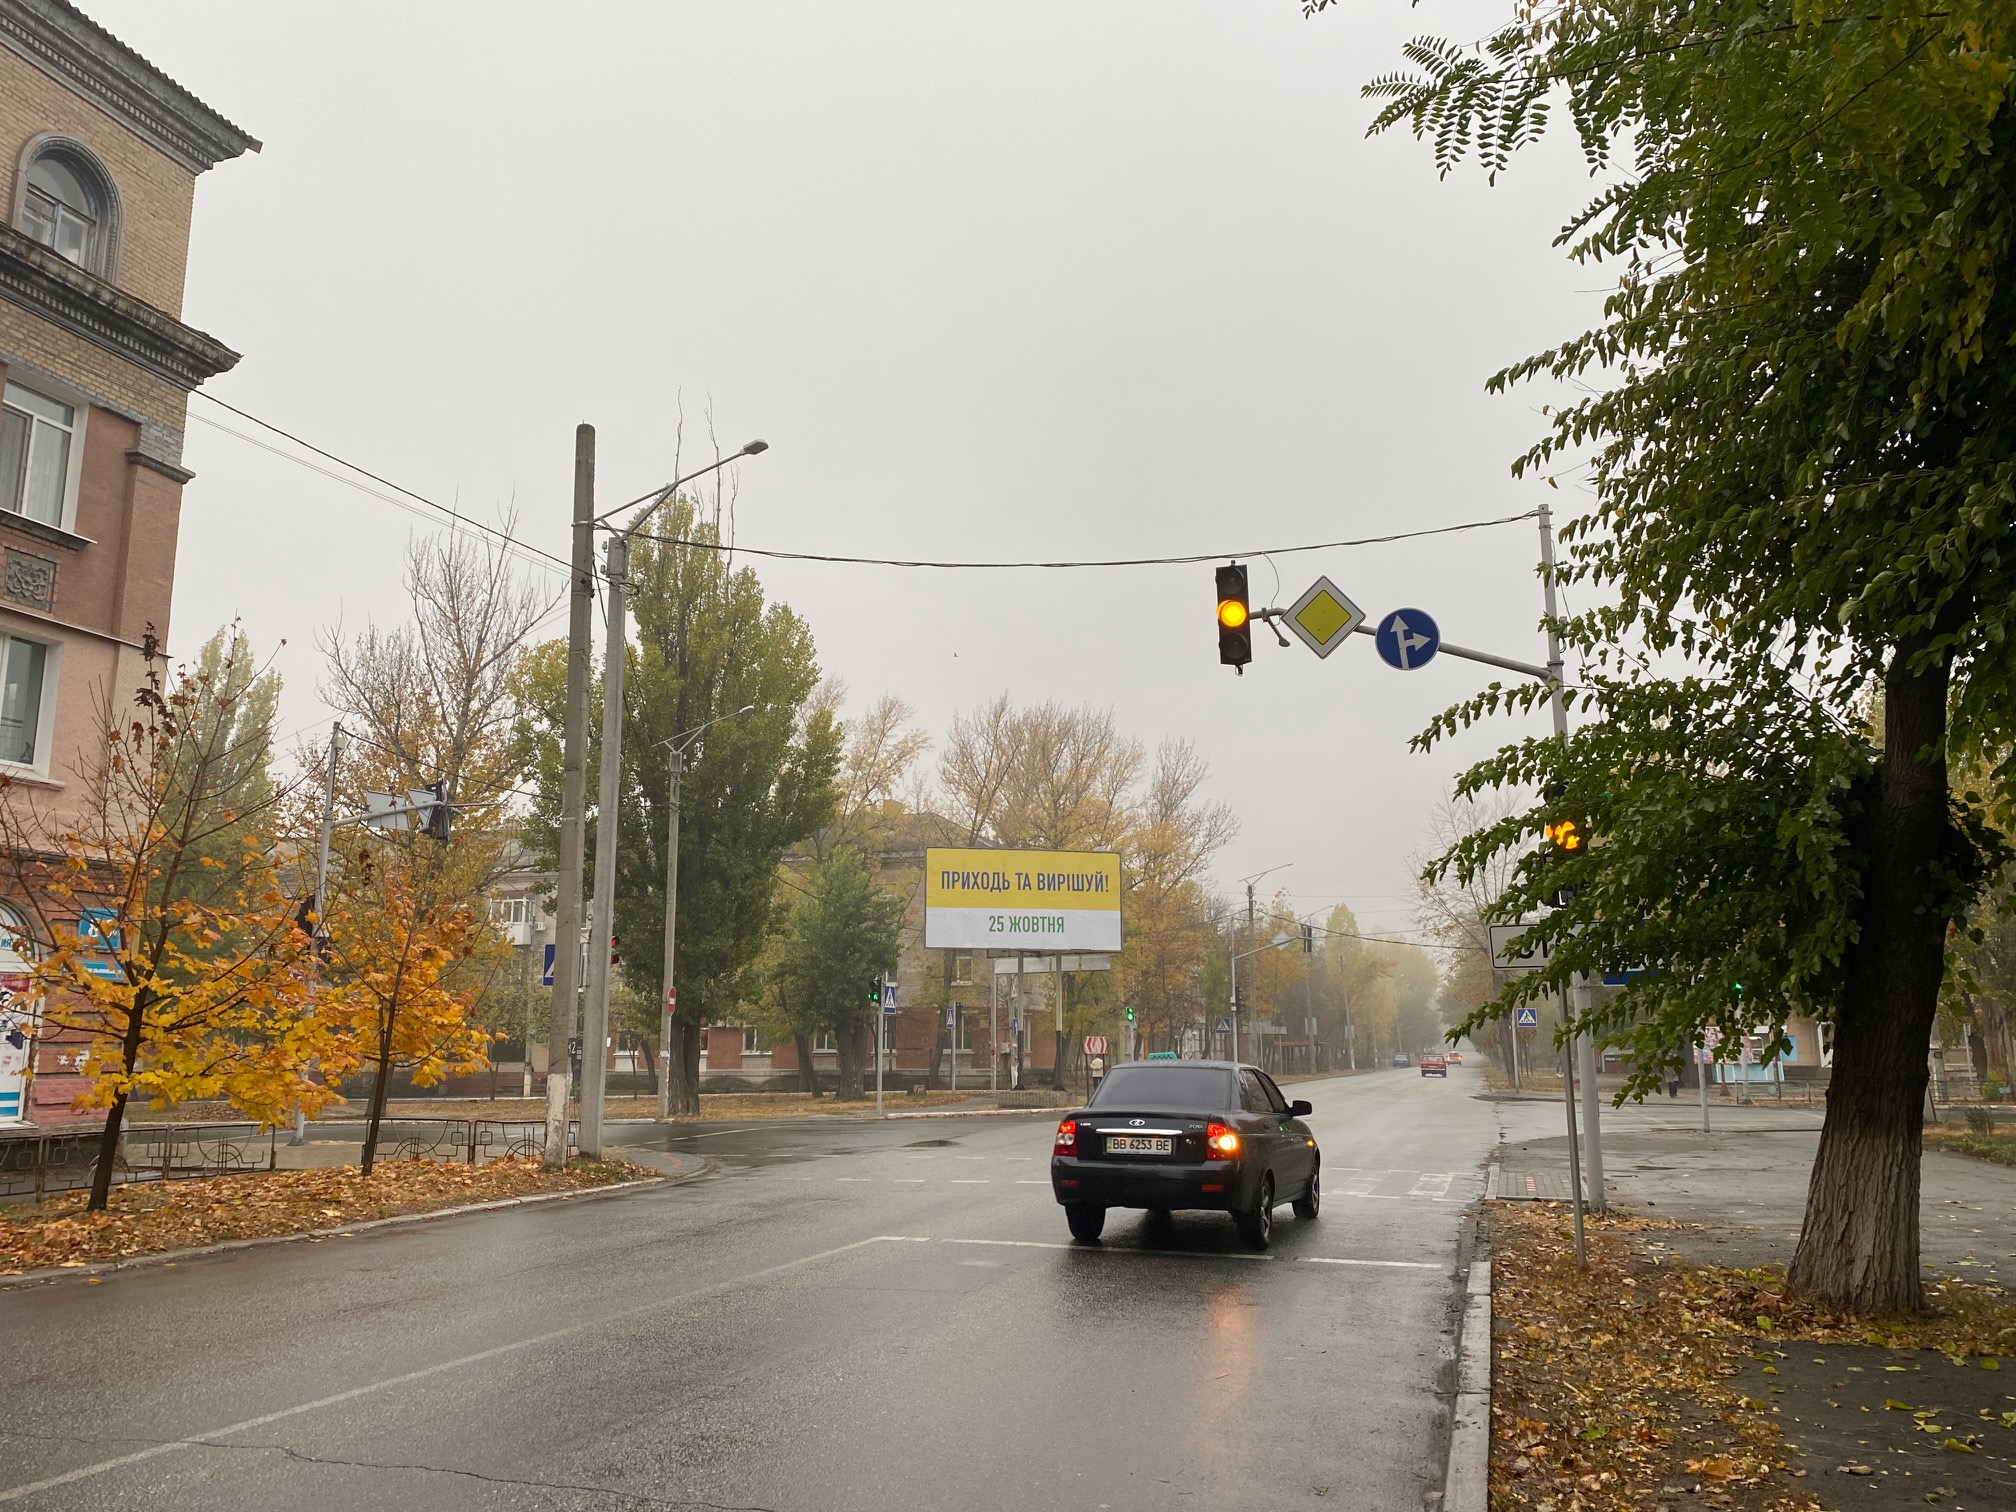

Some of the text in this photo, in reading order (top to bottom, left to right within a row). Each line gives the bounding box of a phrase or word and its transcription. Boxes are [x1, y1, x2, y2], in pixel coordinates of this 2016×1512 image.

[941, 870, 1109, 893] ПРИХОДЬ ТА ВИРІШУЙ!
[988, 915, 1065, 934] 25 ЖОВТНЯ
[1112, 1138, 1170, 1150] BB 6253 BE
